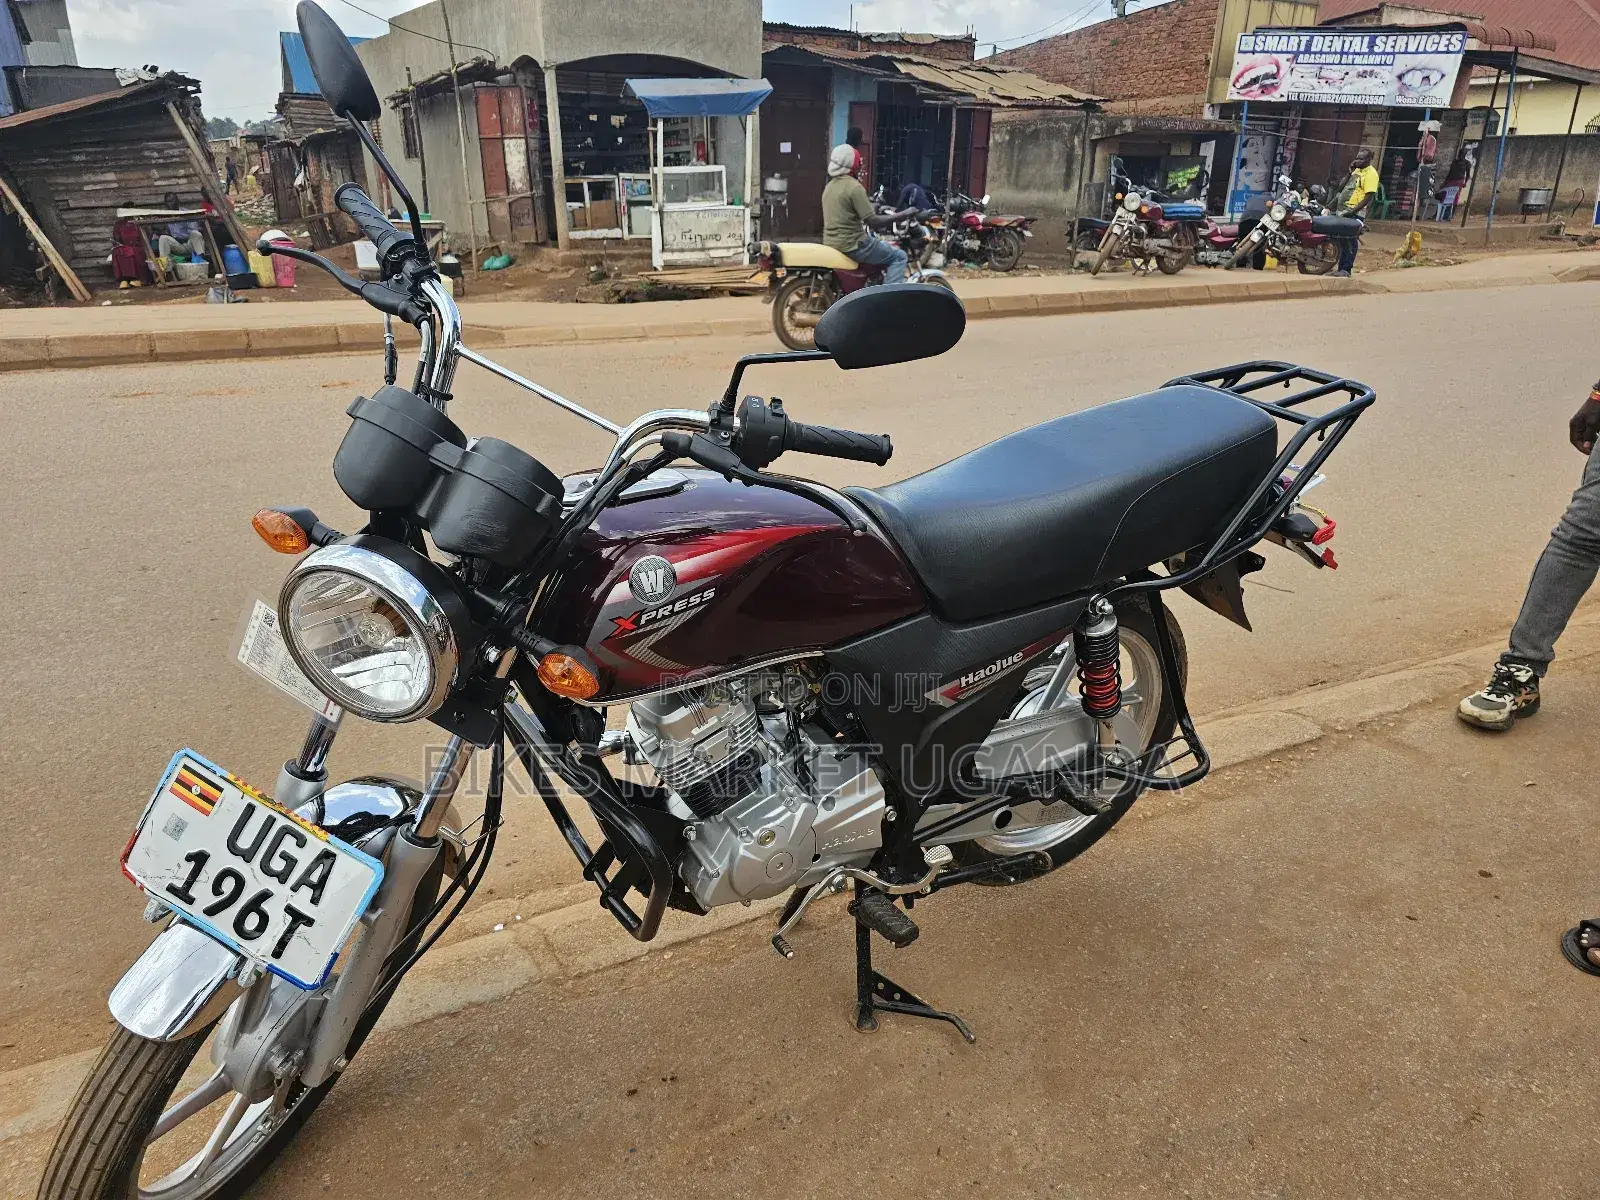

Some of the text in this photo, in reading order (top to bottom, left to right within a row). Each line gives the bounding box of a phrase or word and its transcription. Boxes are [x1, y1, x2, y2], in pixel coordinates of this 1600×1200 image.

[1254, 34, 1464, 53] SMART DENTAL SERVICES
[608, 587, 716, 638] XPRESS
[226, 801, 337, 906] UGA
[165, 849, 316, 960] 196T
